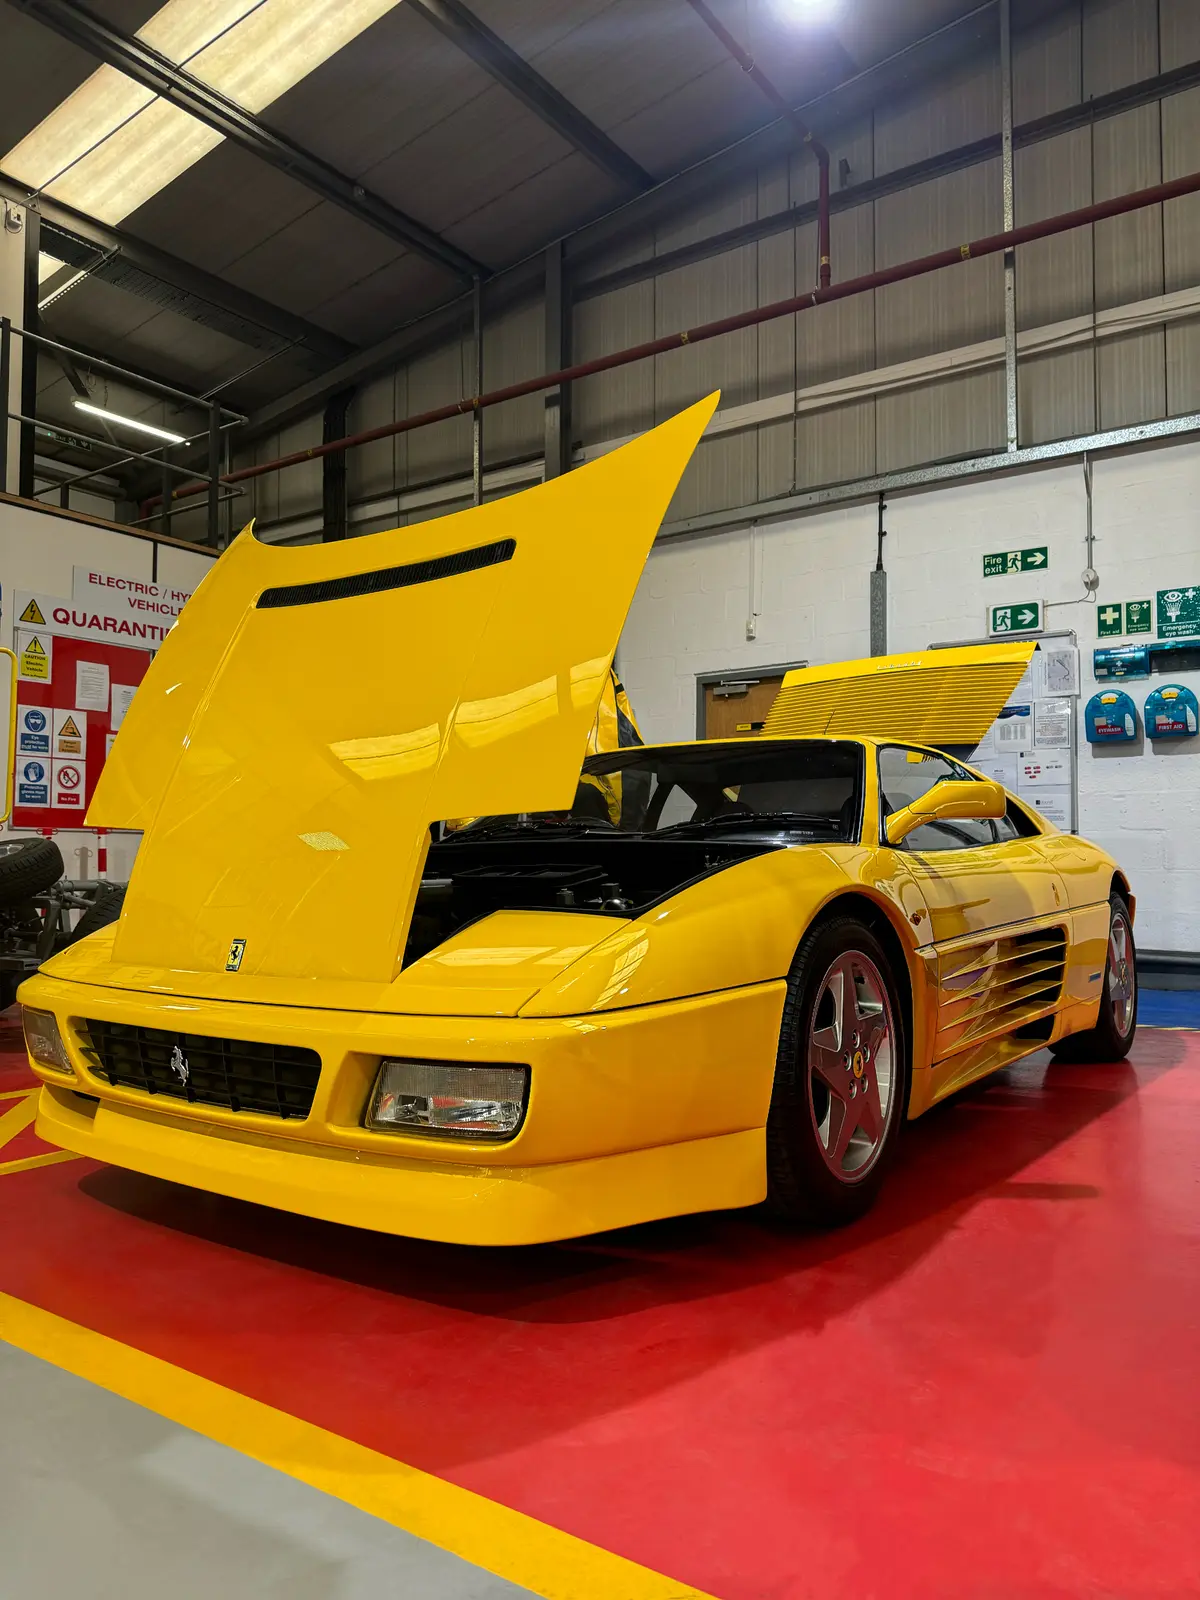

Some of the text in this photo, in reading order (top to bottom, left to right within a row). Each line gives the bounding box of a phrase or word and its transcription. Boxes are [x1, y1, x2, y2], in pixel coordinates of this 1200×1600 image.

[984, 556, 1002, 565] Fire
[984, 565, 1002, 574] exit
[88, 572, 159, 597] ELECTRIC
[162, 588, 168, 599] /
[1162, 623, 1196, 632] Emergency
